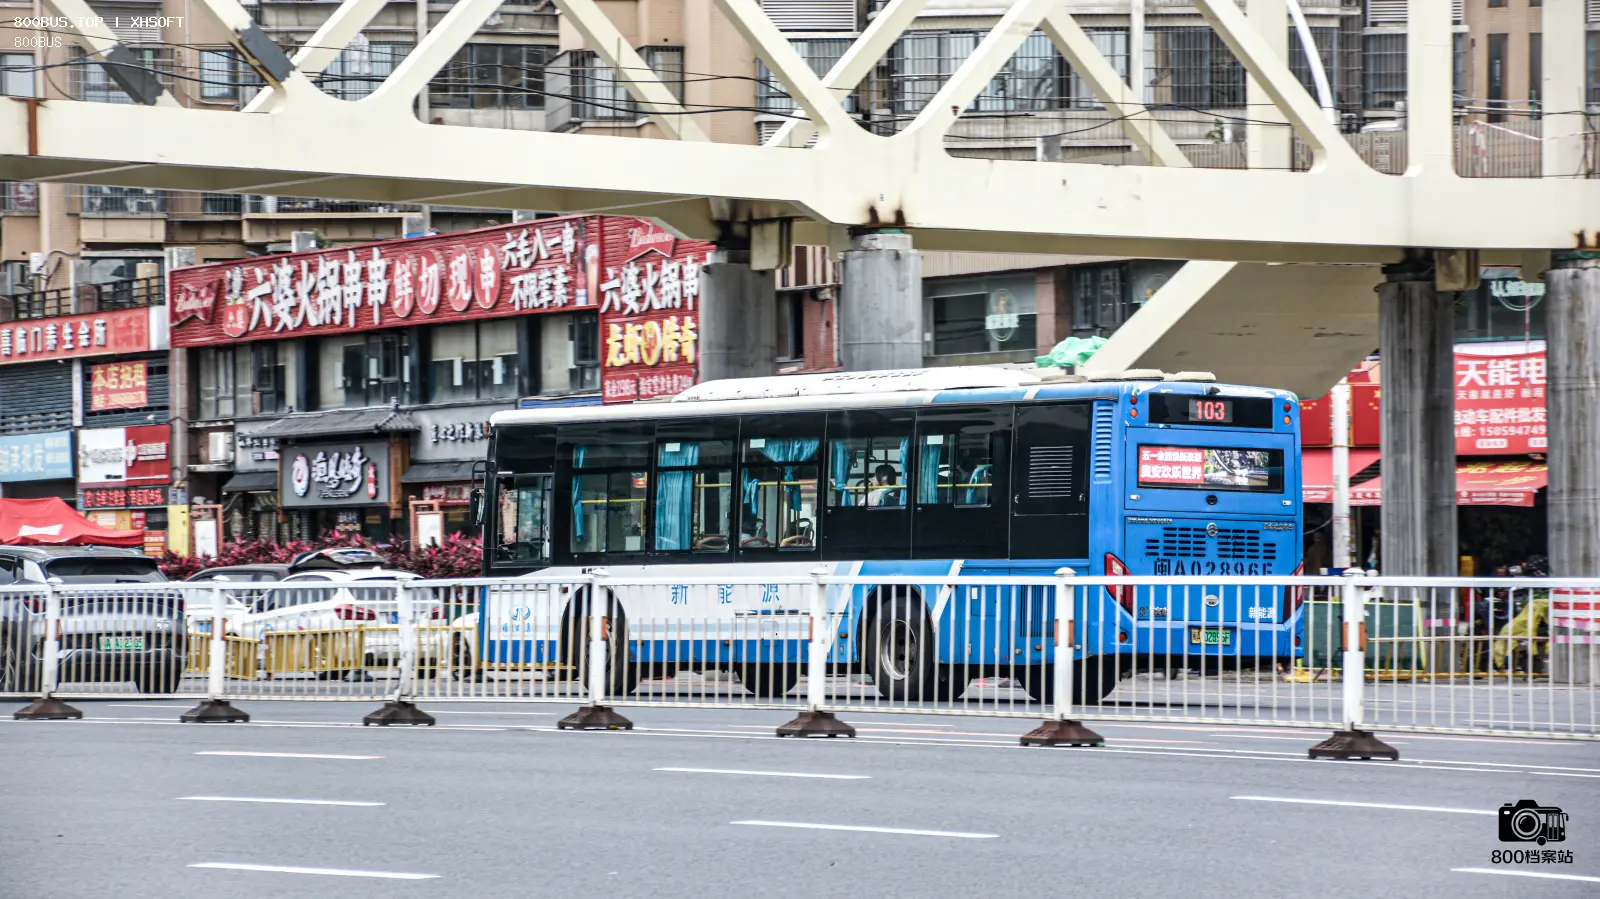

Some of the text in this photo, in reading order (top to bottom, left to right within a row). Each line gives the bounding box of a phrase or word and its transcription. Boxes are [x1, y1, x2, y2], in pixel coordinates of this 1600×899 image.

[248, 247, 389, 333] 六婆火锅串串
[600, 250, 714, 316] 六婆火锅串
[1456, 358, 1547, 387] 天能电
[1196, 401, 1225, 421] 103
